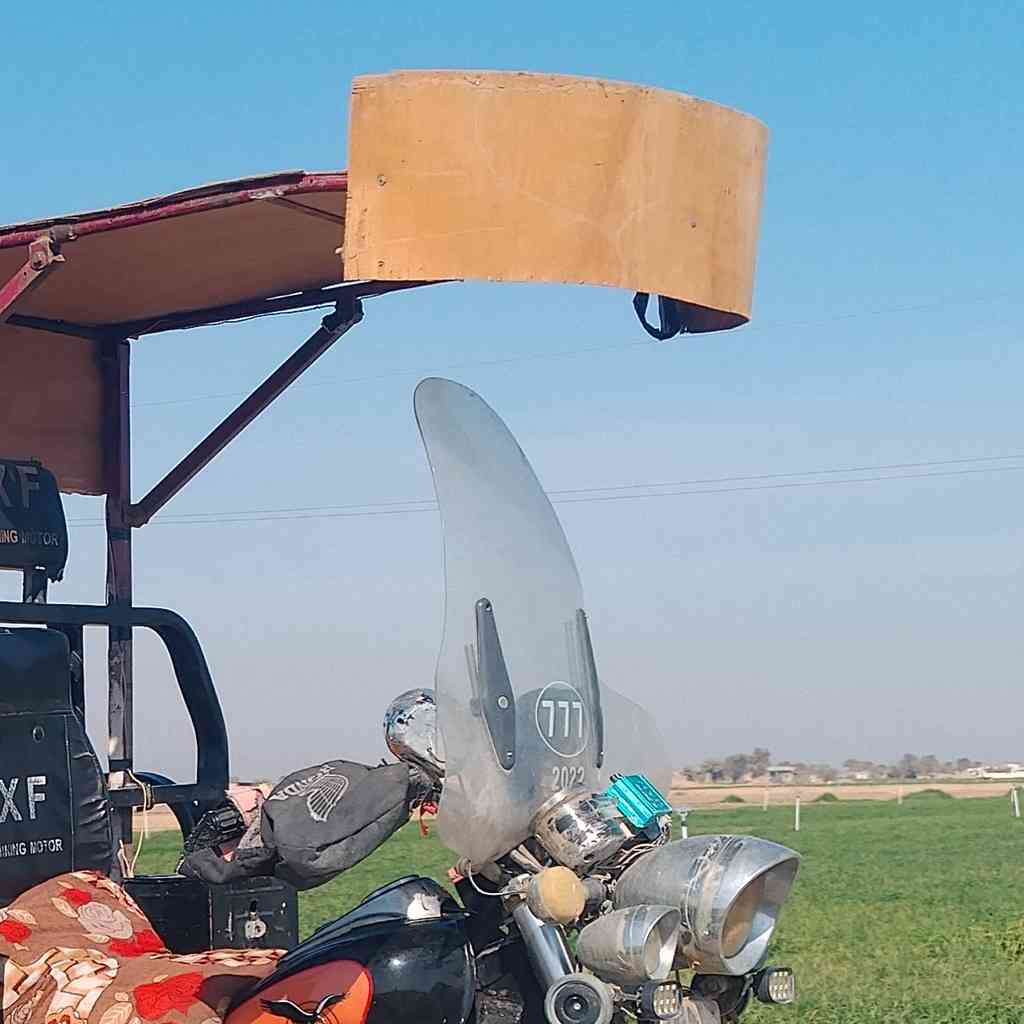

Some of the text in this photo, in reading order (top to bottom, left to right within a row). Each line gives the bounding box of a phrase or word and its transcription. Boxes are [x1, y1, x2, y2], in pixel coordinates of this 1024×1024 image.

[542, 700, 583, 738] 777
[552, 766, 585, 791] 2022
[29, 839, 63, 855] MOTOR
